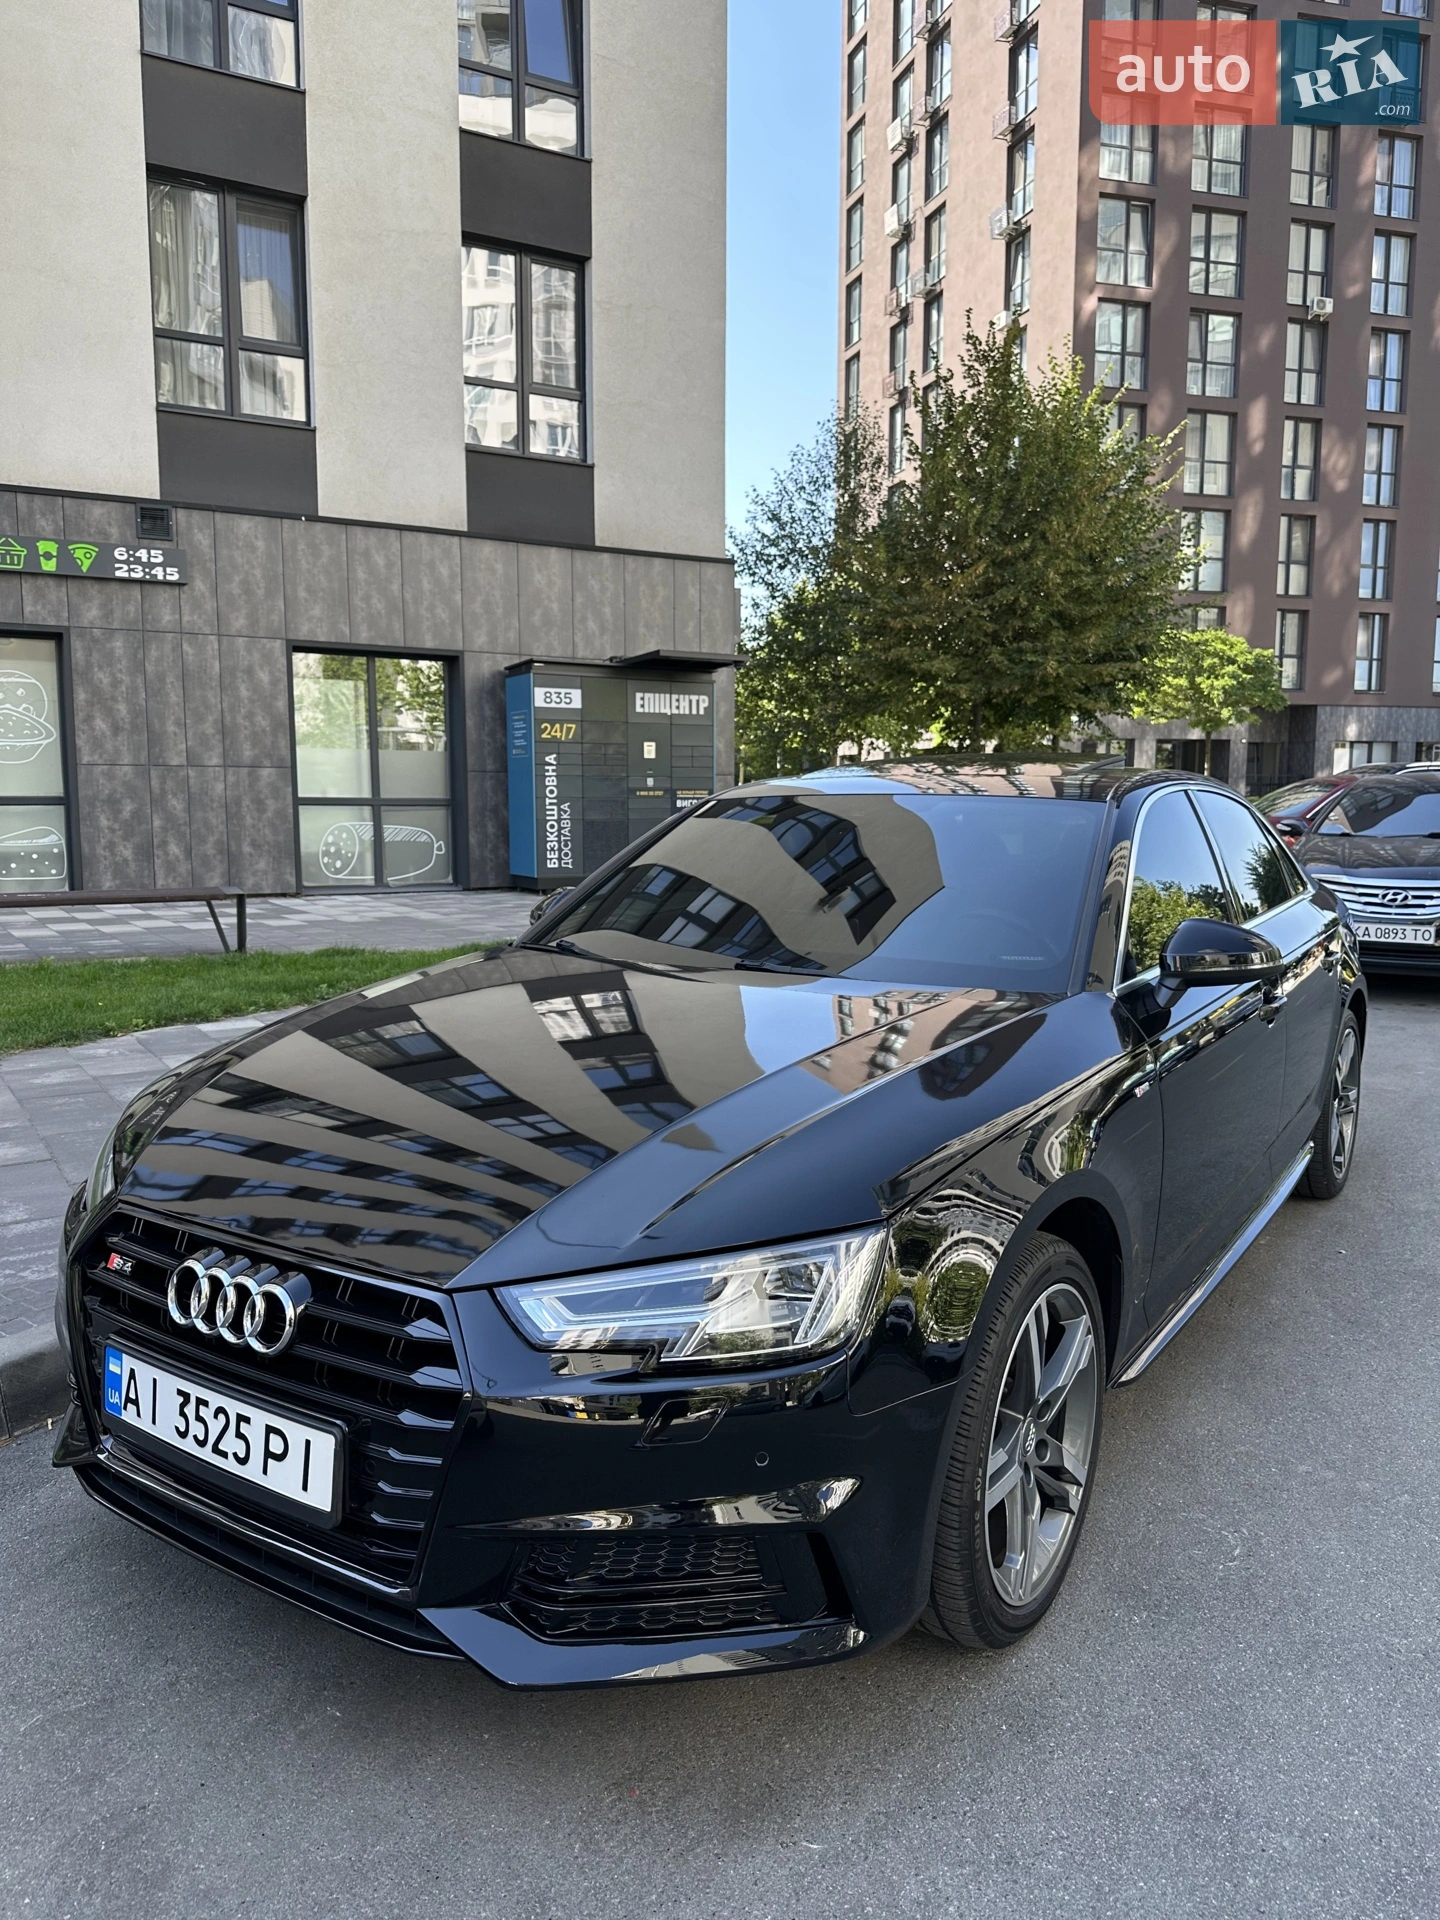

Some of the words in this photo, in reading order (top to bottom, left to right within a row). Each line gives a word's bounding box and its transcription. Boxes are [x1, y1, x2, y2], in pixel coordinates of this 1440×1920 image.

[113, 546, 164, 564] 6:45
[114, 563, 180, 581] 23:45
[543, 691, 573, 706] 835
[635, 692, 709, 716] ЕПІЦЕНТР
[540, 722, 577, 742] 24/7
[544, 753, 560, 870] БЕЗКОШТОВНА
[561, 802, 573, 869] ДОСТАВКА
[1375, 927, 1407, 940] 0893
[1411, 928, 1432, 942] TO
[108, 1387, 121, 1408] UA
[123, 1367, 157, 1425] AI
[174, 1387, 251, 1466] 3525
[262, 1423, 311, 1493] PI
